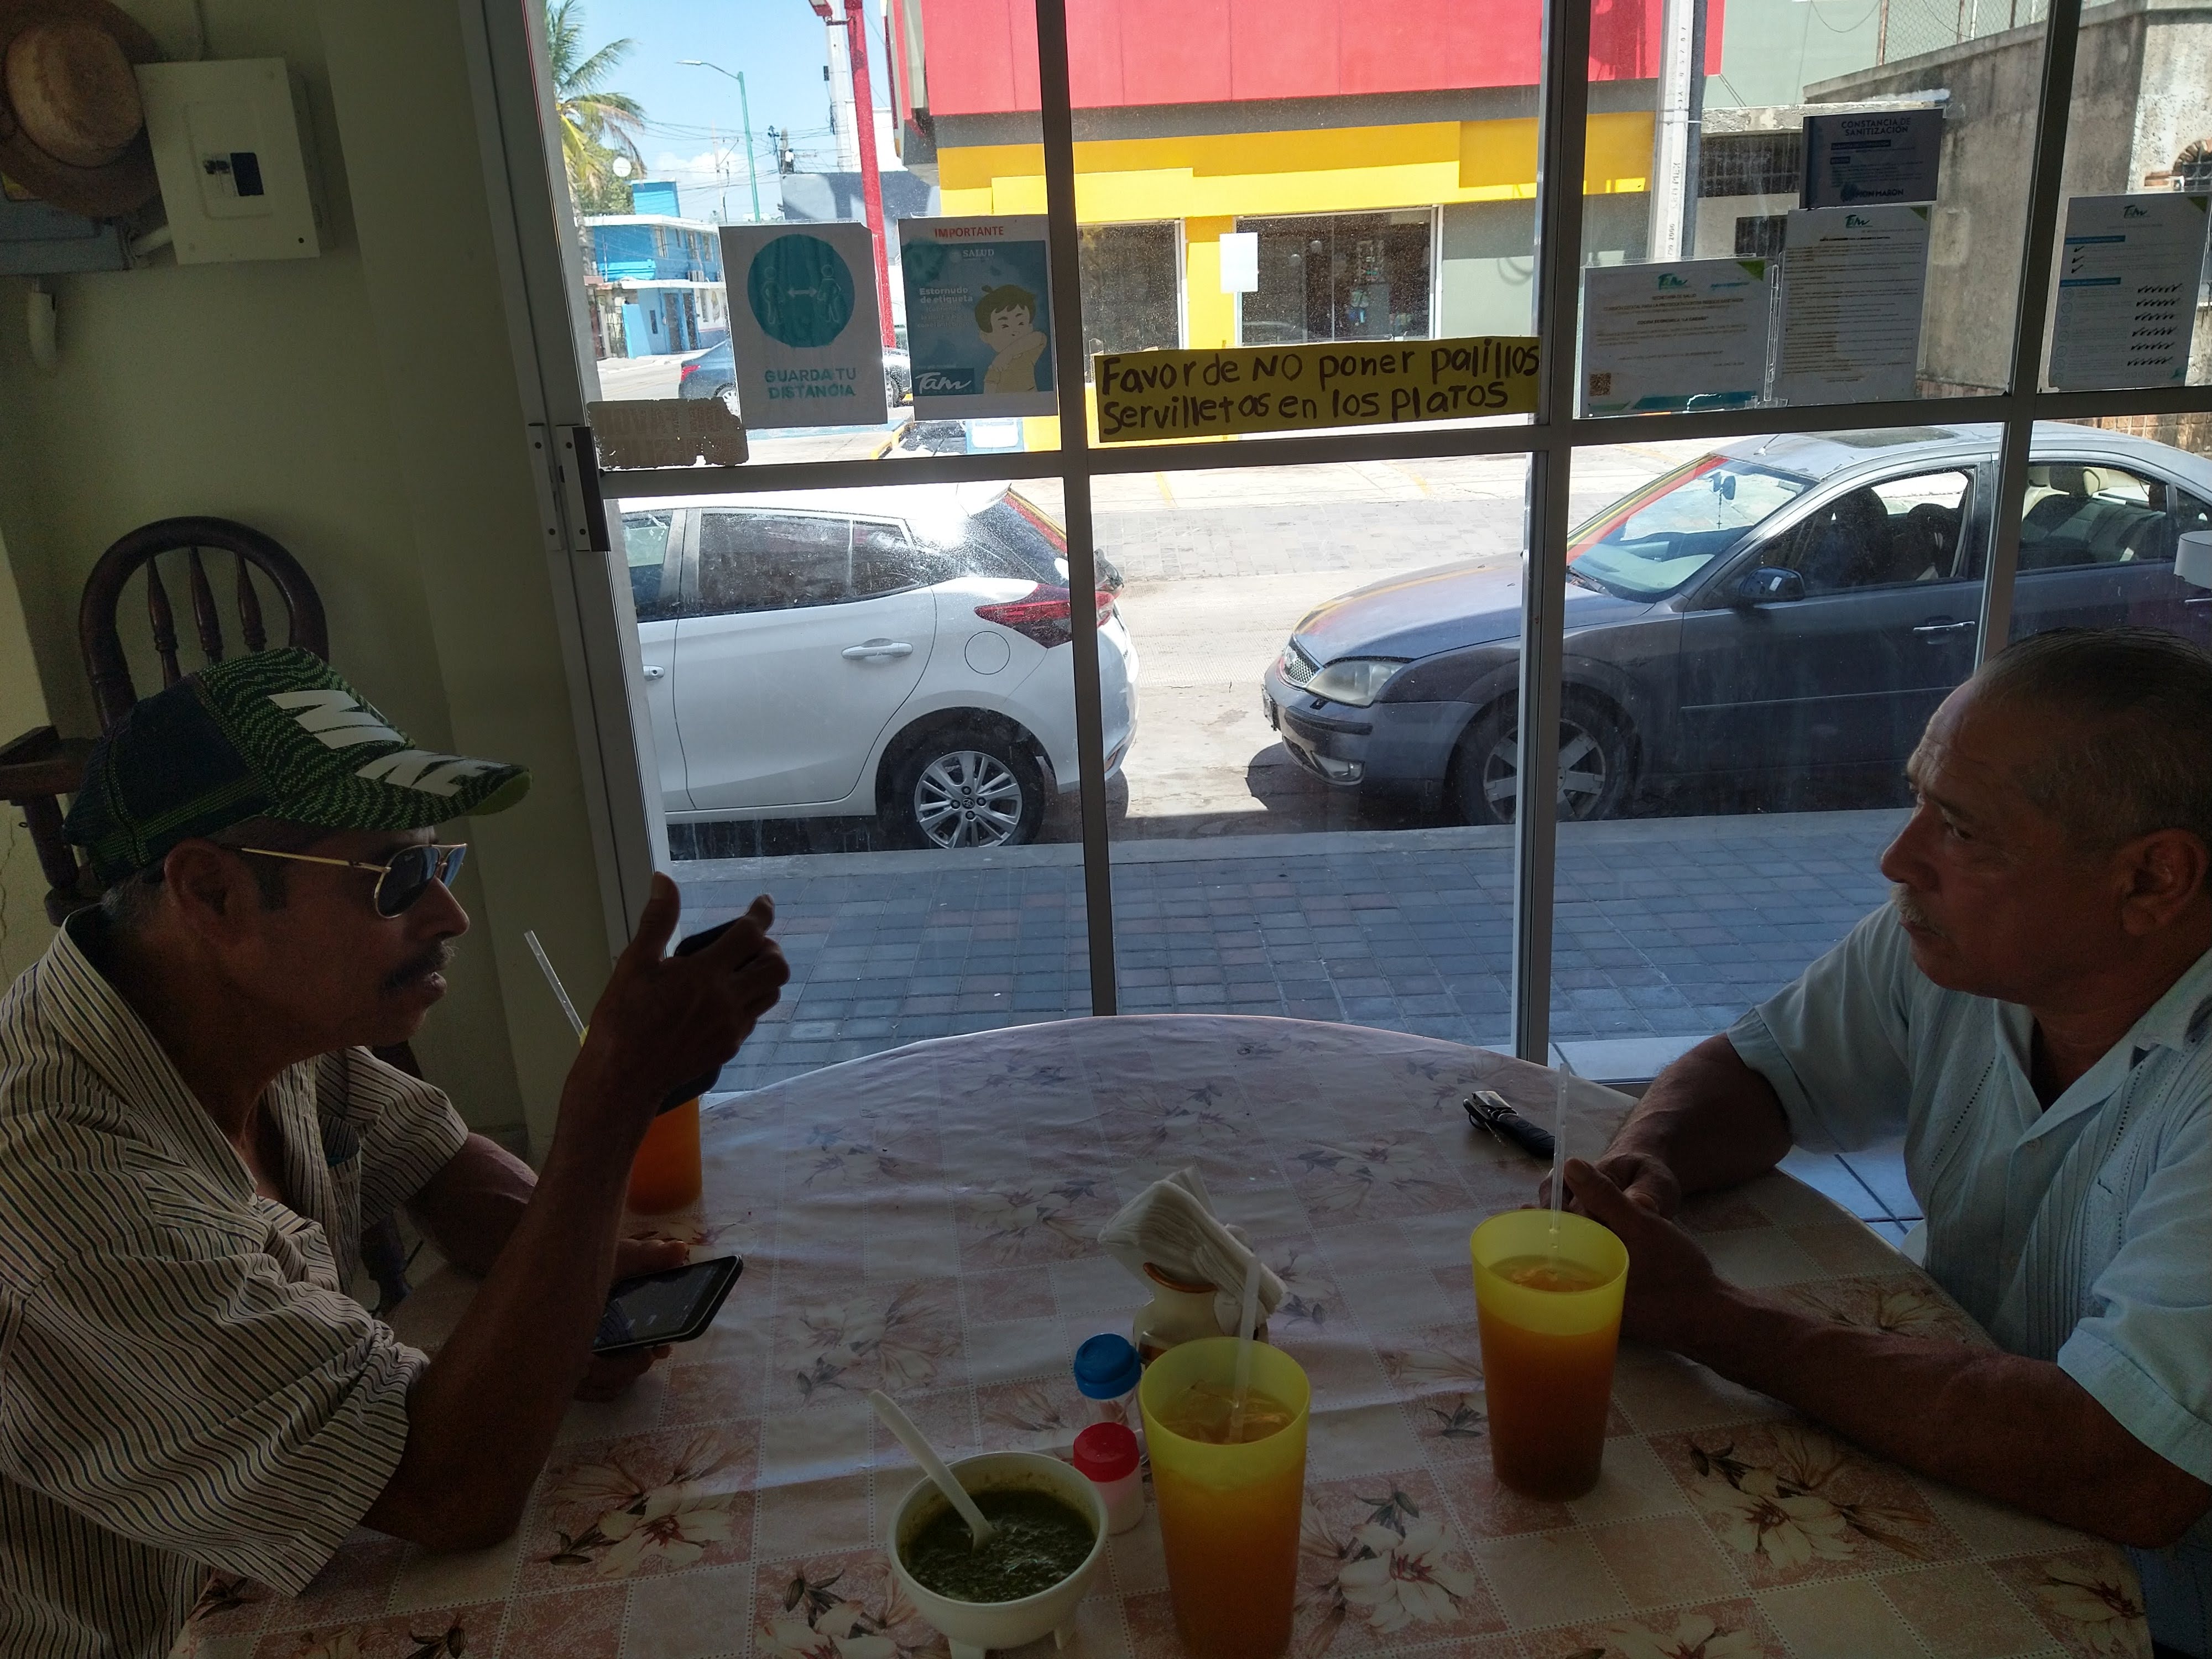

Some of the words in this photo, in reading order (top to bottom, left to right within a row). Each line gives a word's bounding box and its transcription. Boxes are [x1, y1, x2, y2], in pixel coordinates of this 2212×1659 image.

[1841, 118, 1898, 129] CONSTANCIA
[935, 226, 1004, 238] IMPORTANTE
[962, 249, 994, 257] SALUD
[919, 286, 969, 296] Estornudo
[933, 294, 973, 304] etiqueta
[1102, 357, 1197, 395] Favor
[1203, 353, 1240, 386] de
[1253, 353, 1303, 382] NO
[1319, 350, 1416, 392] poner
[1431, 338, 1540, 385] palillos
[764, 368, 832, 383] GUARDA
[836, 368, 857, 380] TU
[915, 371, 972, 394] Tam
[768, 384, 856, 399] DISTANCIA
[1279, 395, 1317, 420] en
[1332, 389, 1380, 418] los
